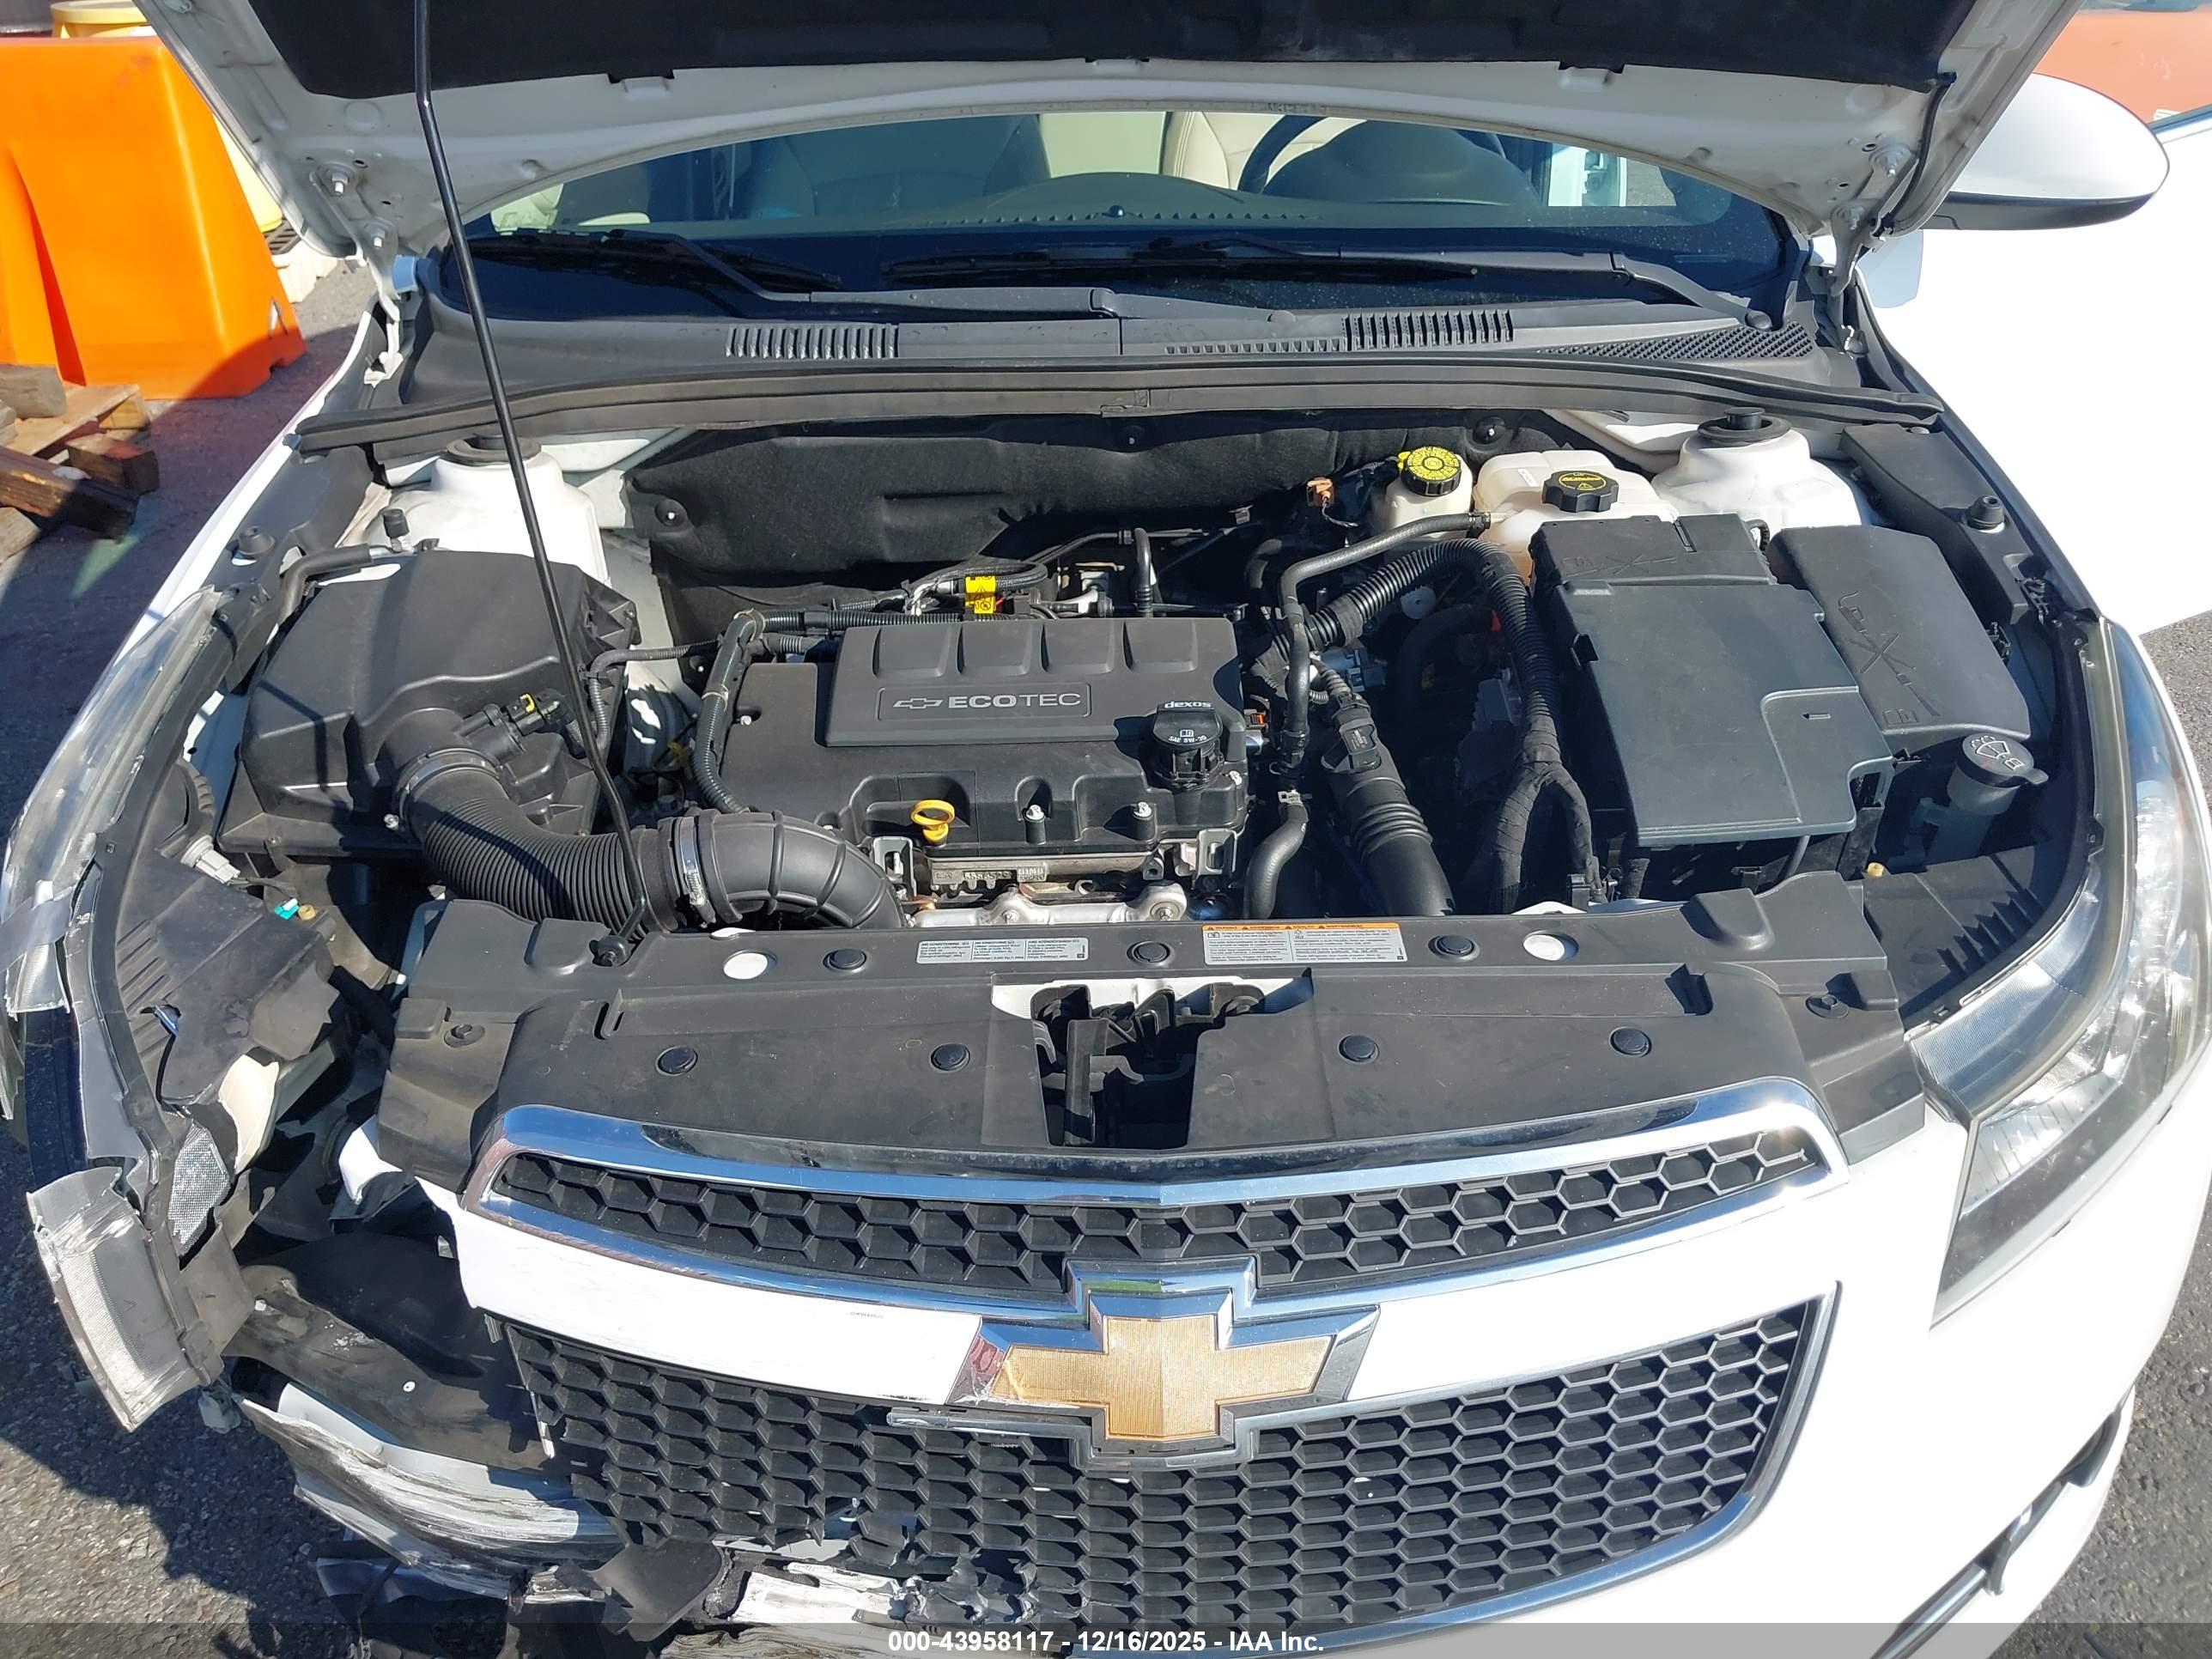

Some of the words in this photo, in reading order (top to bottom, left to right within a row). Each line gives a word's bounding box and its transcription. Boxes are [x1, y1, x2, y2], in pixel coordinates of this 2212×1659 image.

[948, 693, 1081, 709] ECOTEC
[1168, 735, 1182, 744] SAE
[1183, 734, 1208, 744] 5W-30
